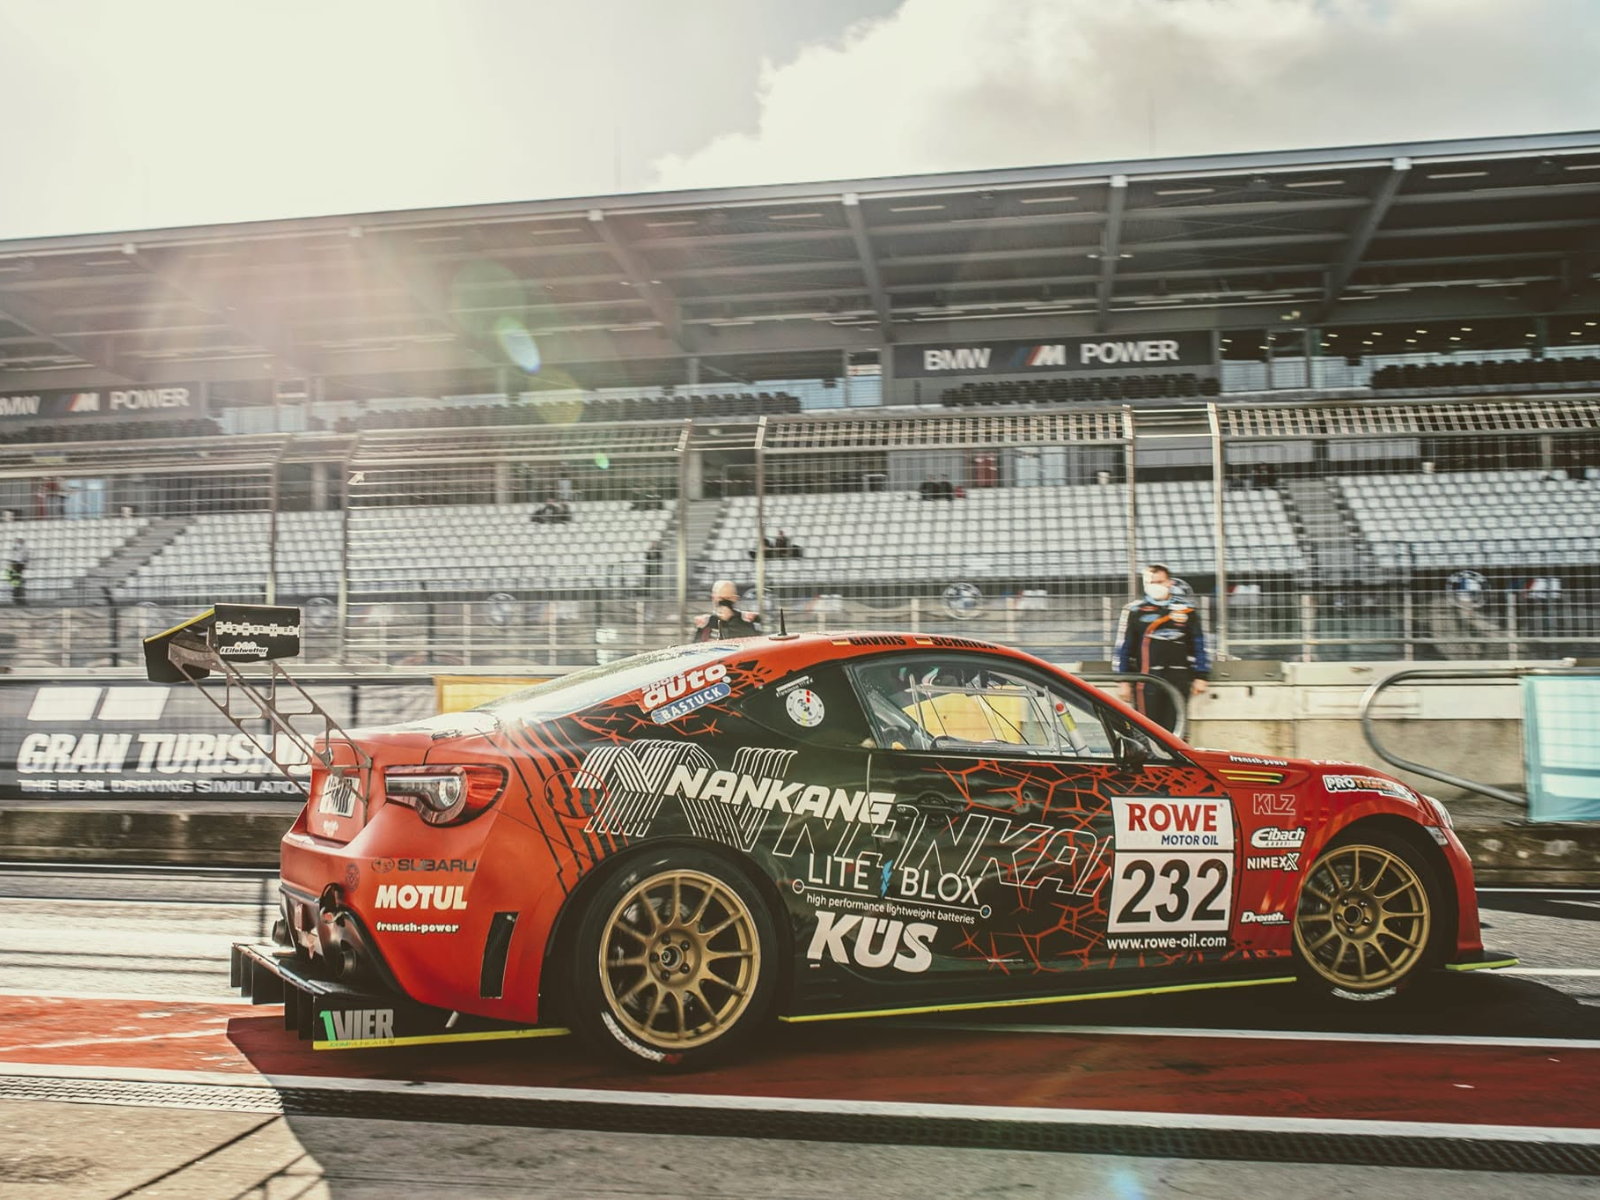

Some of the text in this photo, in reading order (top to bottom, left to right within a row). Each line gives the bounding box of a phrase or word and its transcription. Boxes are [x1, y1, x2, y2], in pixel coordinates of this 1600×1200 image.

[923, 340, 1179, 370] BMW M POWER
[0, 396, 41, 415] MW
[110, 388, 190, 410] POWER
[643, 663, 727, 708] auto
[661, 687, 723, 720] BASTUCK
[17, 733, 132, 774] GRAN
[17, 779, 57, 793] THE
[664, 764, 897, 825] NANKANG
[1125, 803, 1218, 832] ROWE
[1253, 793, 1296, 815] KLZ
[1160, 834, 1219, 846] MOTOR OIL
[1252, 827, 1305, 847] Eibach
[397, 859, 477, 872] SUBARU
[808, 853, 983, 905] LITE BLOX
[374, 884, 468, 910] MOTUL
[1116, 858, 1229, 924] 232
[807, 893, 975, 925] high performance lightweight batteries
[376, 921, 459, 934] frensch-power
[807, 910, 939, 973] KÜS
[1107, 933, 1227, 950] www.rowe-oil.com
